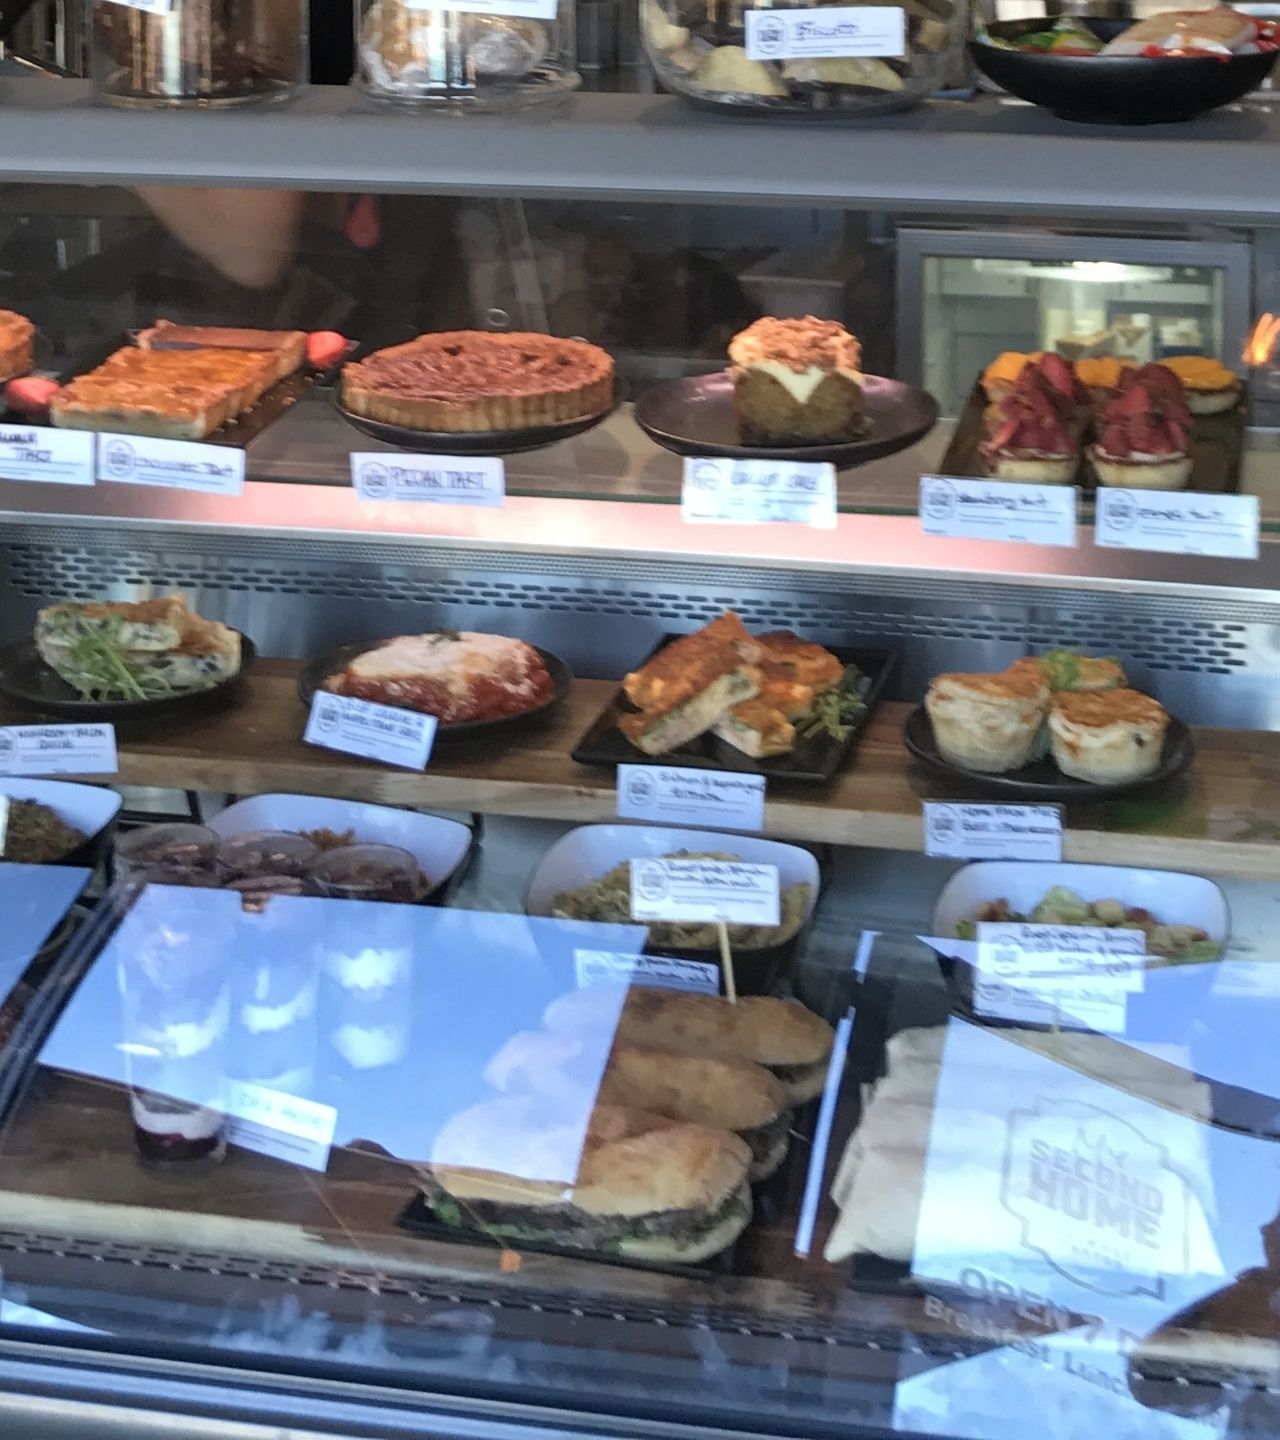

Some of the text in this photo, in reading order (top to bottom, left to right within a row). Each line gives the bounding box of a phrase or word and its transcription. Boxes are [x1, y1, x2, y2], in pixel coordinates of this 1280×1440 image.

[1026, 1162, 1162, 1250] HOME
[1030, 1137, 1165, 1213] SECOND
[959, 1266, 1071, 1332] OPEN
